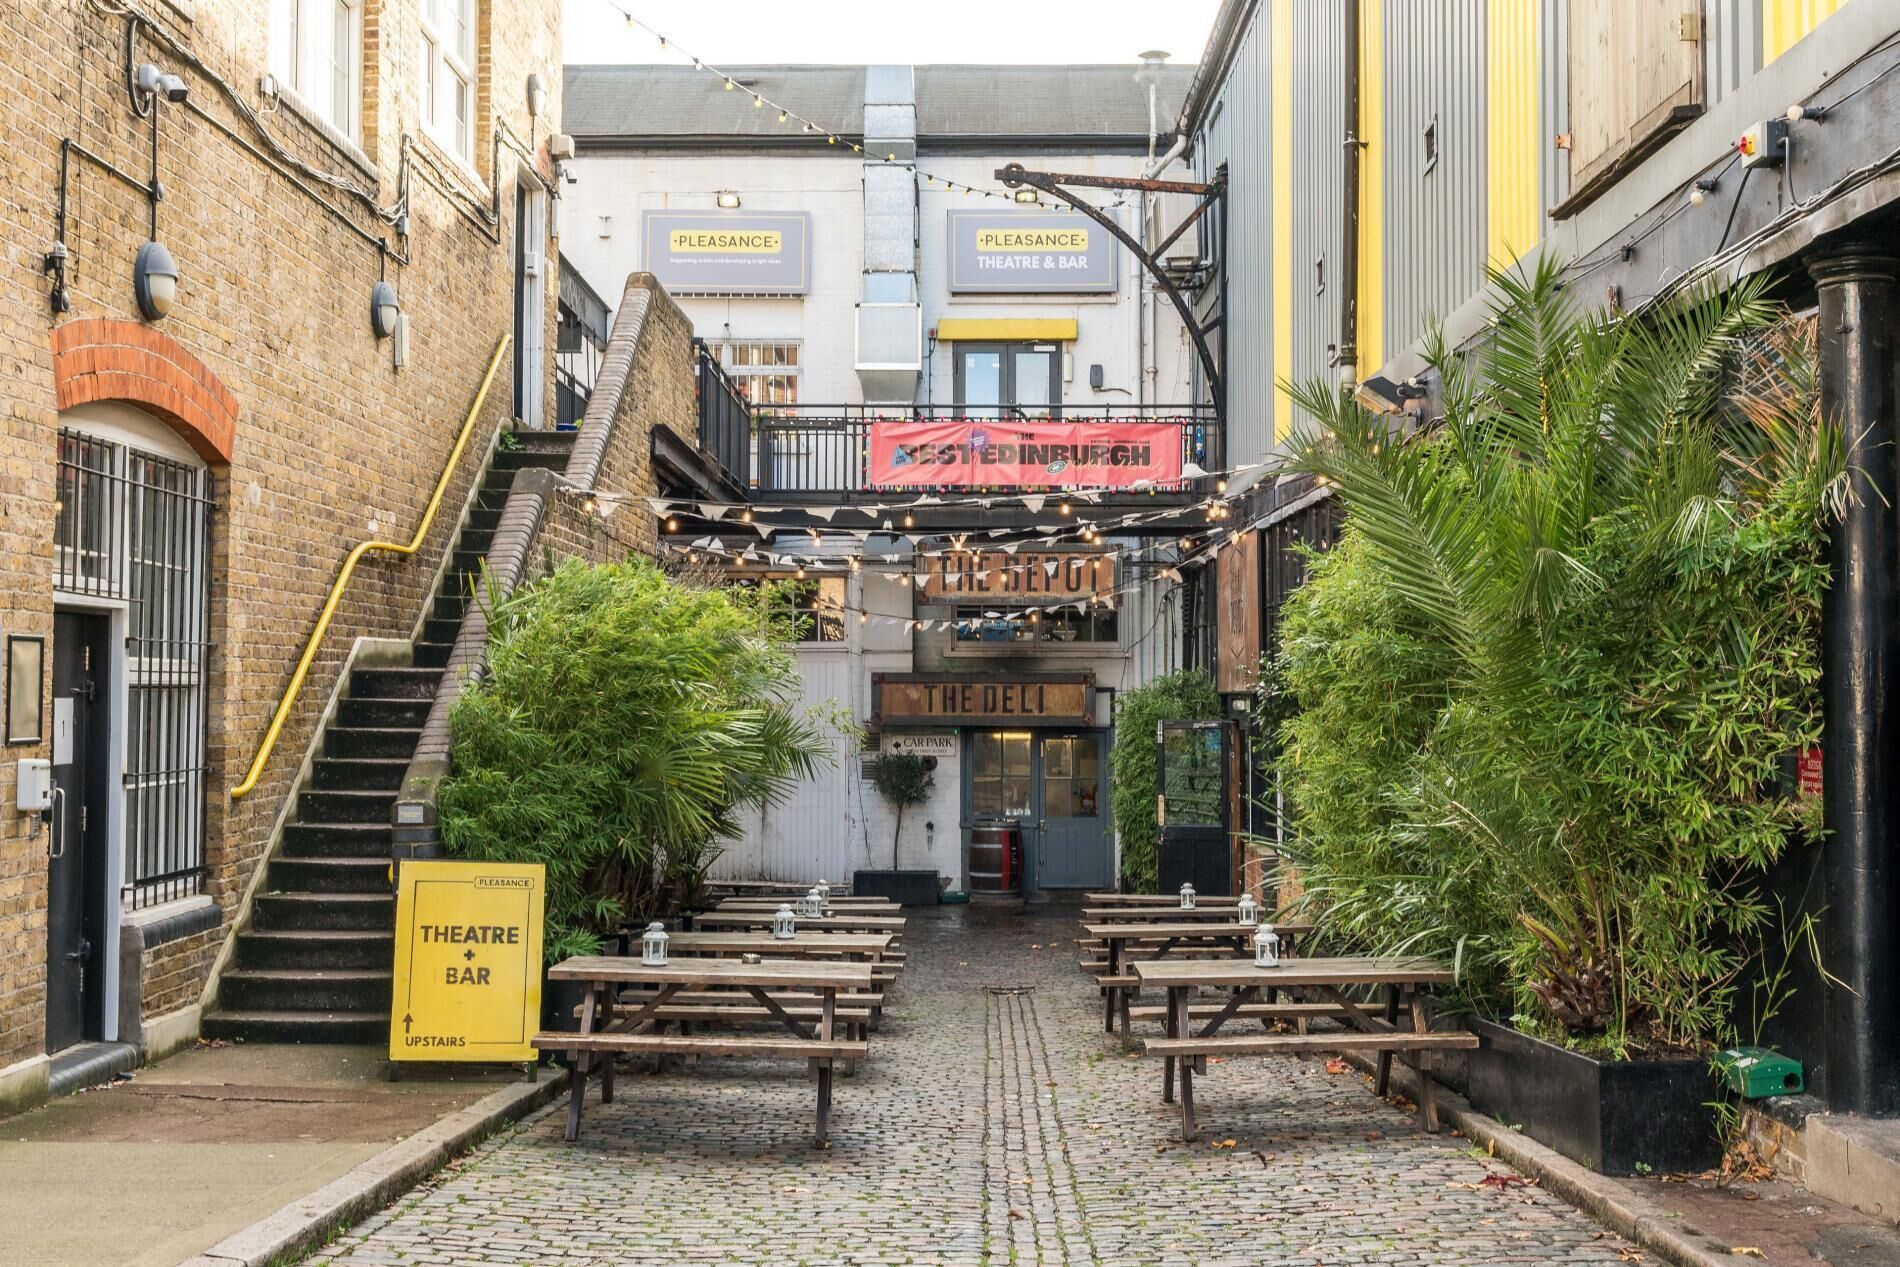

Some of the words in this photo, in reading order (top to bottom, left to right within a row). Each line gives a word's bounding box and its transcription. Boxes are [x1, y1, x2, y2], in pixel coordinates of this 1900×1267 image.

[679, 235, 774, 248] PLEASANCE
[985, 234, 1080, 246] PLEASANCE
[977, 255, 1040, 269] THEATRE
[1043, 255, 1056, 269] &
[1058, 256, 1088, 269] BAR
[980, 443, 1151, 467] EDINBURGH
[937, 556, 990, 592] THE
[924, 684, 972, 713] THE
[983, 684, 1045, 714] DELI
[903, 737, 924, 747] CAR
[926, 736, 952, 748] PARK
[479, 879, 530, 887] PLEASANCE
[420, 925, 519, 944] THEATRE
[445, 967, 491, 985] BAR
[405, 1036, 466, 1047] UPSTAIRS
